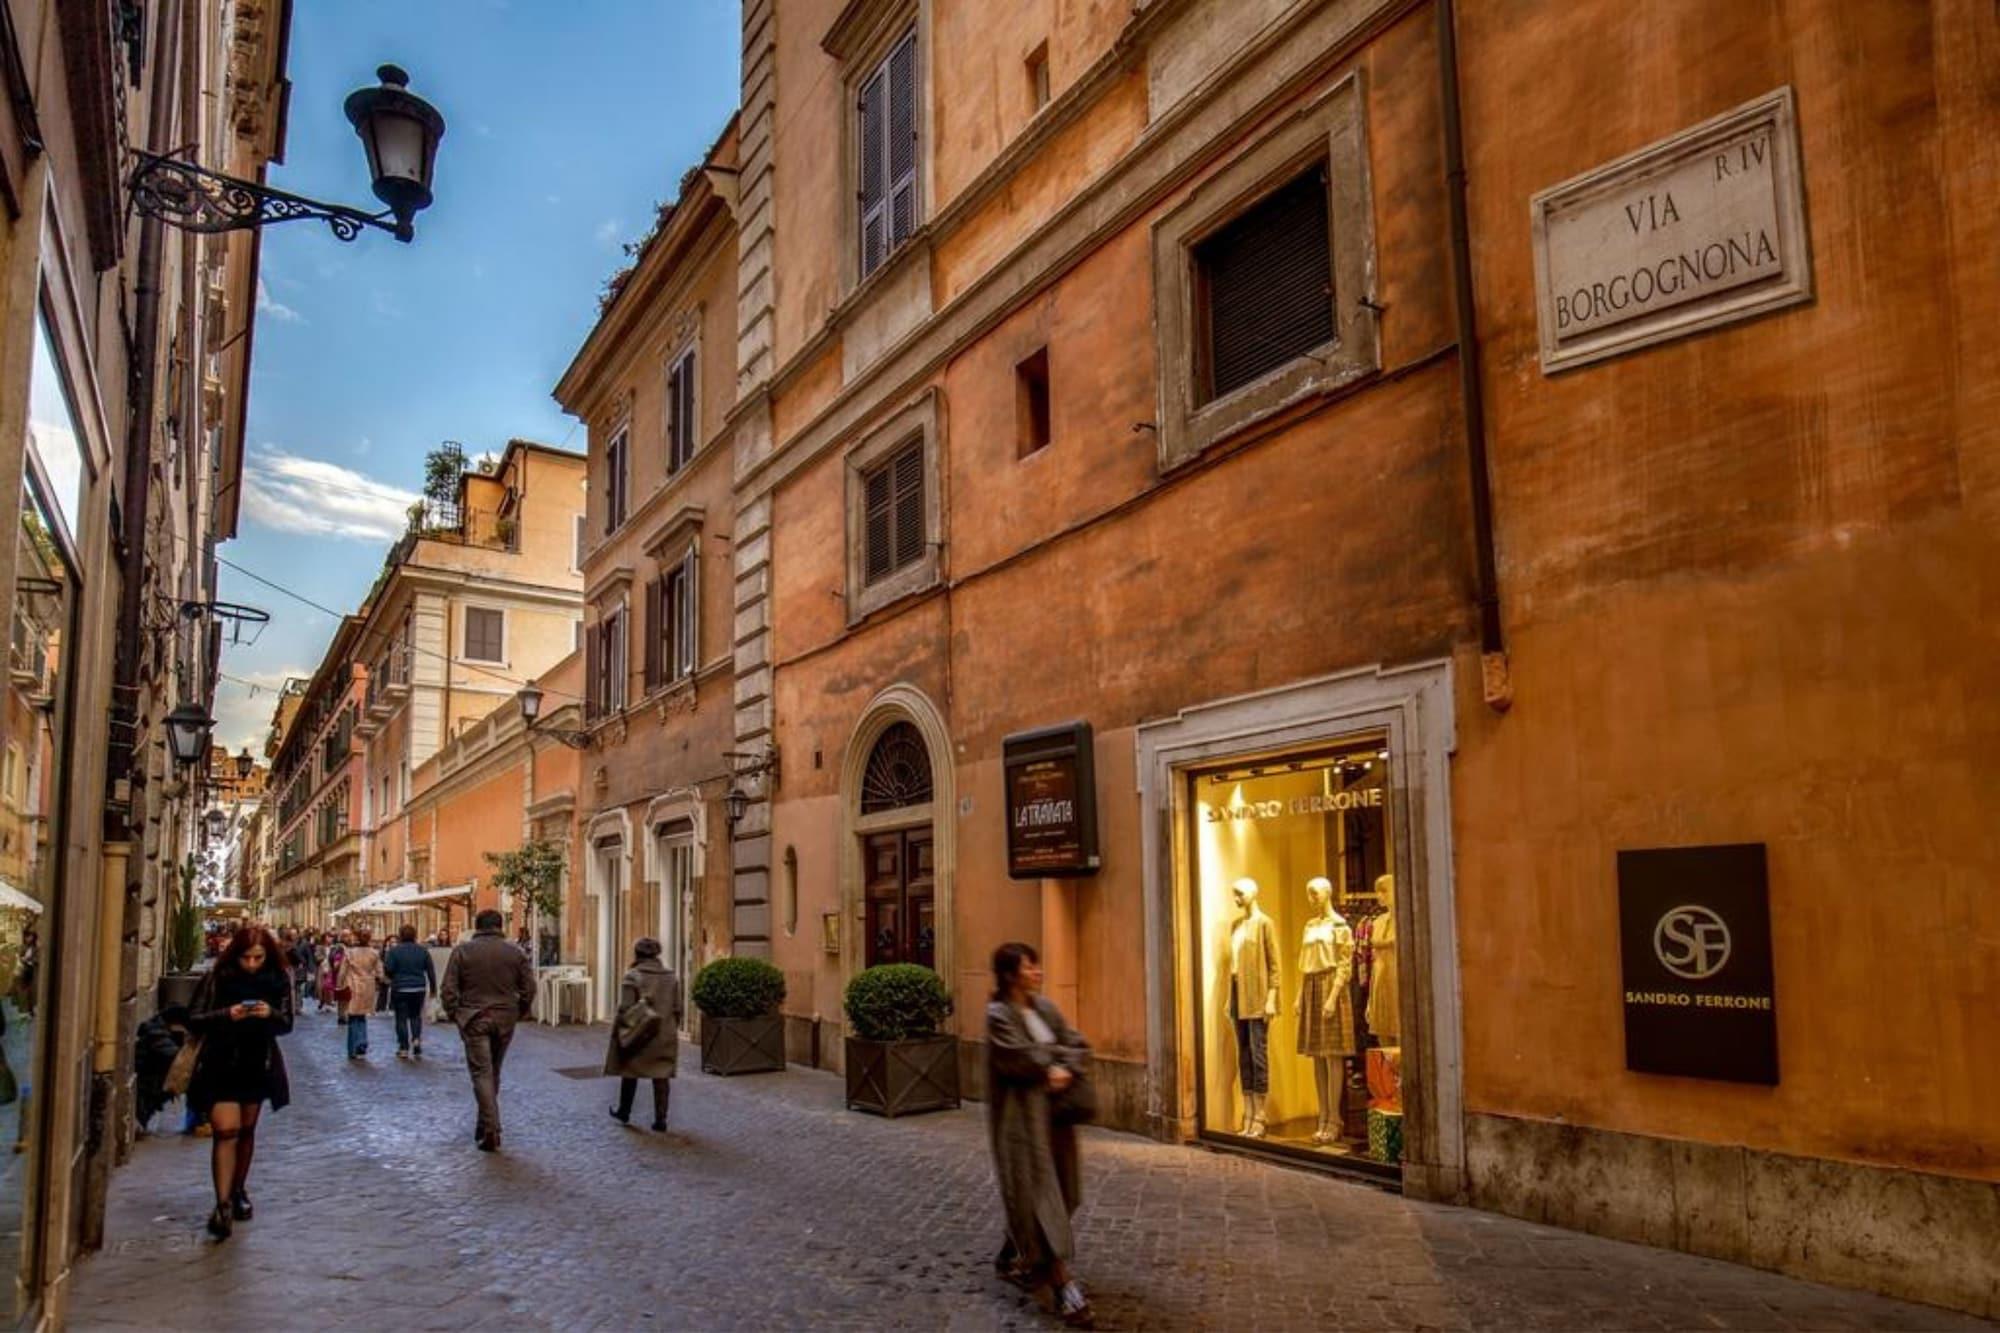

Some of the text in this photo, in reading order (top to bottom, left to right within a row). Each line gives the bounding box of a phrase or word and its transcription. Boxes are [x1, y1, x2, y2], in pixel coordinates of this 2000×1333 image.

[1714, 137, 1766, 181] R IV
[1625, 192, 1681, 235] VIA
[1557, 229, 1777, 329] BORGOGNONA
[1288, 788, 1383, 816] FERRONE
[1662, 912, 1728, 974] SF
[1625, 991, 1771, 1010] SANDRO FERRONE
